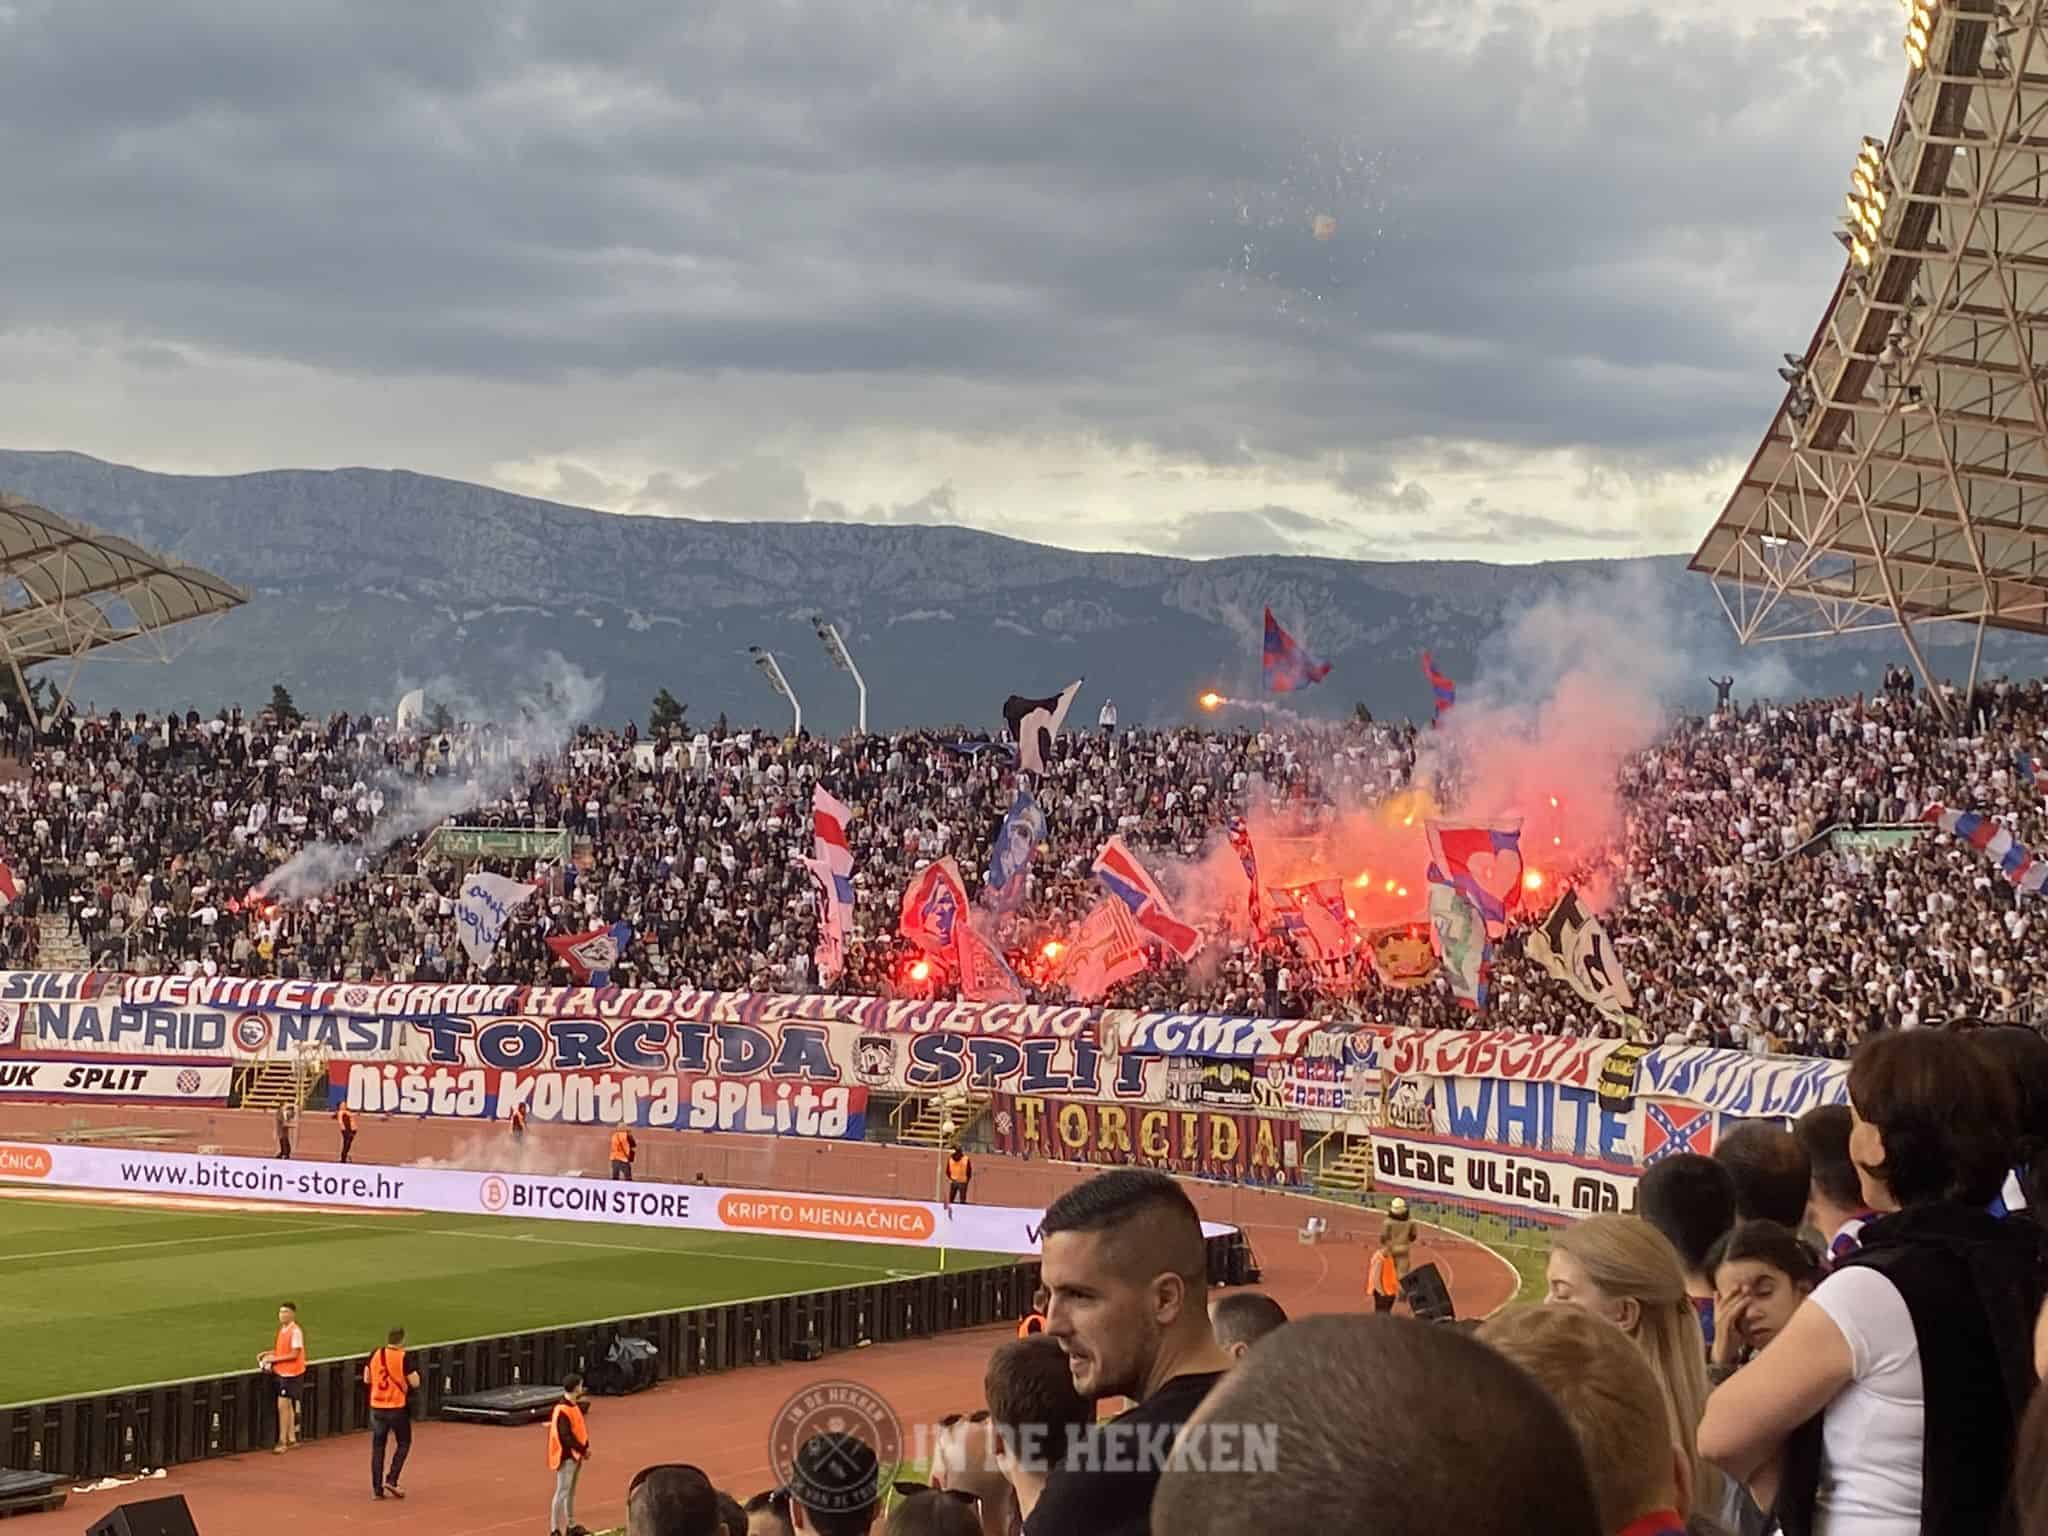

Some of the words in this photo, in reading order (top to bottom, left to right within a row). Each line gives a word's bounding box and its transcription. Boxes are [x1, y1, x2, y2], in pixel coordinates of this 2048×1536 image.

[123, 976, 338, 1011] IDENTITET
[377, 984, 518, 1015] GRADA
[523, 986, 750, 1022] HAJDUK
[39, 1003, 227, 1050] NAPRID
[414, 1016, 842, 1081] TORCIDA
[905, 1033, 1163, 1097] SPLIT
[63, 1066, 148, 1091] SPLIT
[1015, 1096, 1279, 1168] TORCIDA
[1444, 1076, 1635, 1166] WHITE
[121, 1162, 404, 1200] www.bitcoin-store.hr
[513, 1184, 607, 1212] BITCOIN
[612, 1191, 690, 1218] STORE
[727, 1201, 793, 1222] KRIPTO
[799, 1207, 926, 1232] MJENJAČNICA
